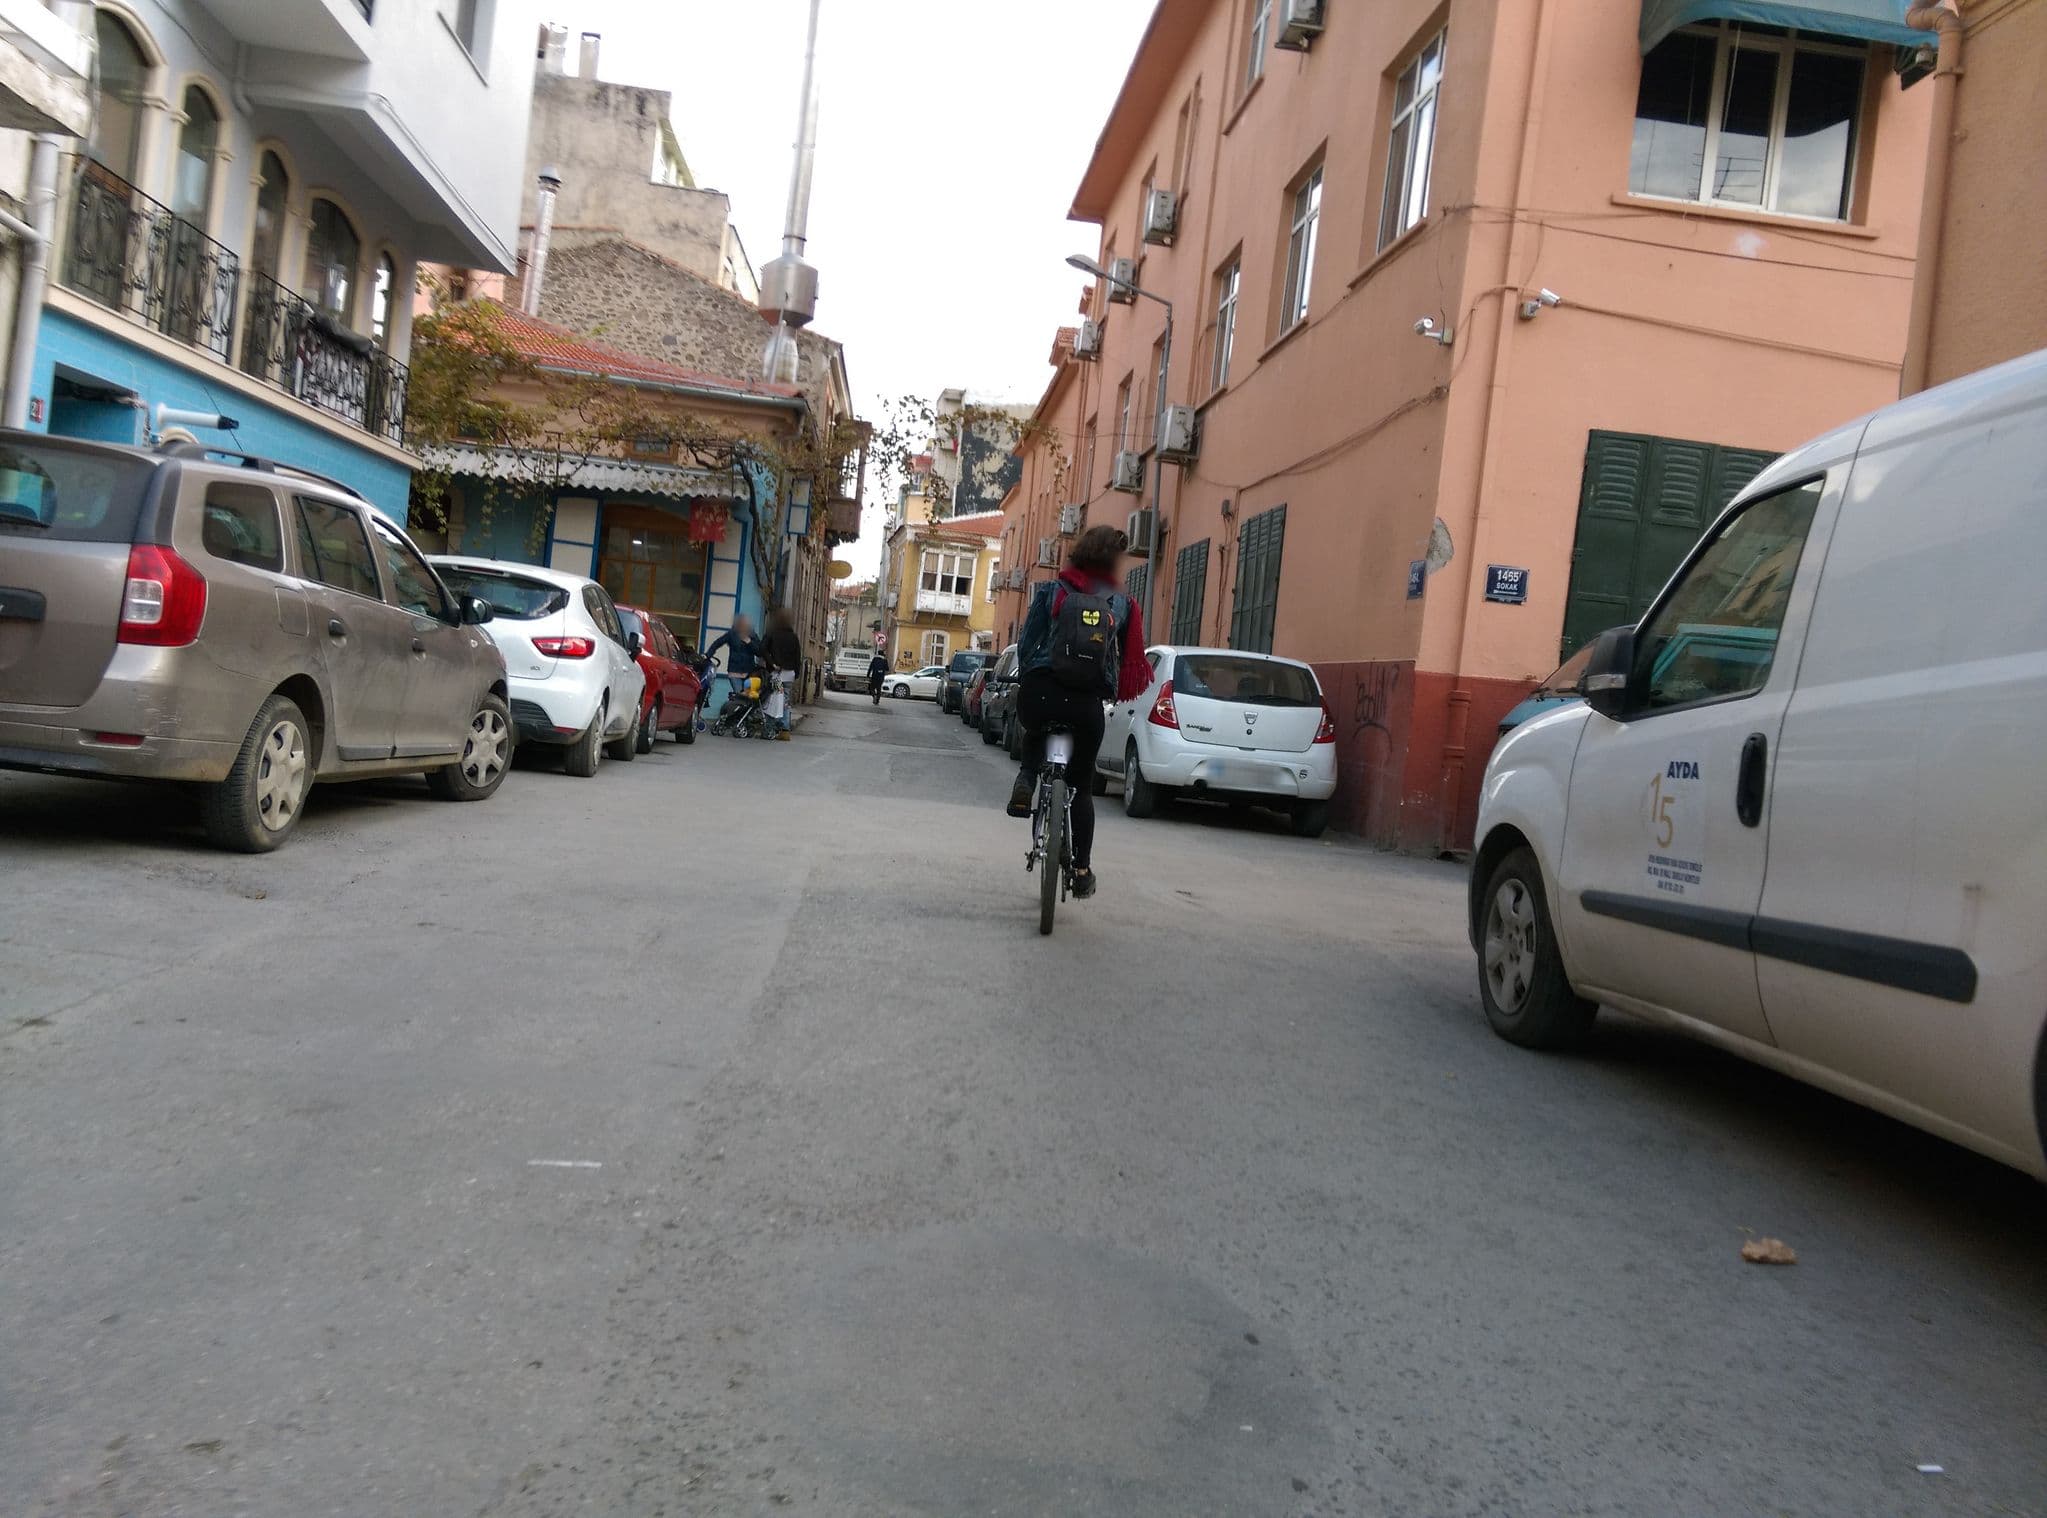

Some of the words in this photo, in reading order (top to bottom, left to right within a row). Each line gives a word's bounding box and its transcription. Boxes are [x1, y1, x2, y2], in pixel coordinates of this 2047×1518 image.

[1496, 582, 1518, 591] SOKAK
[1666, 761, 1700, 780] AYDA
[1650, 772, 1676, 849] 15
